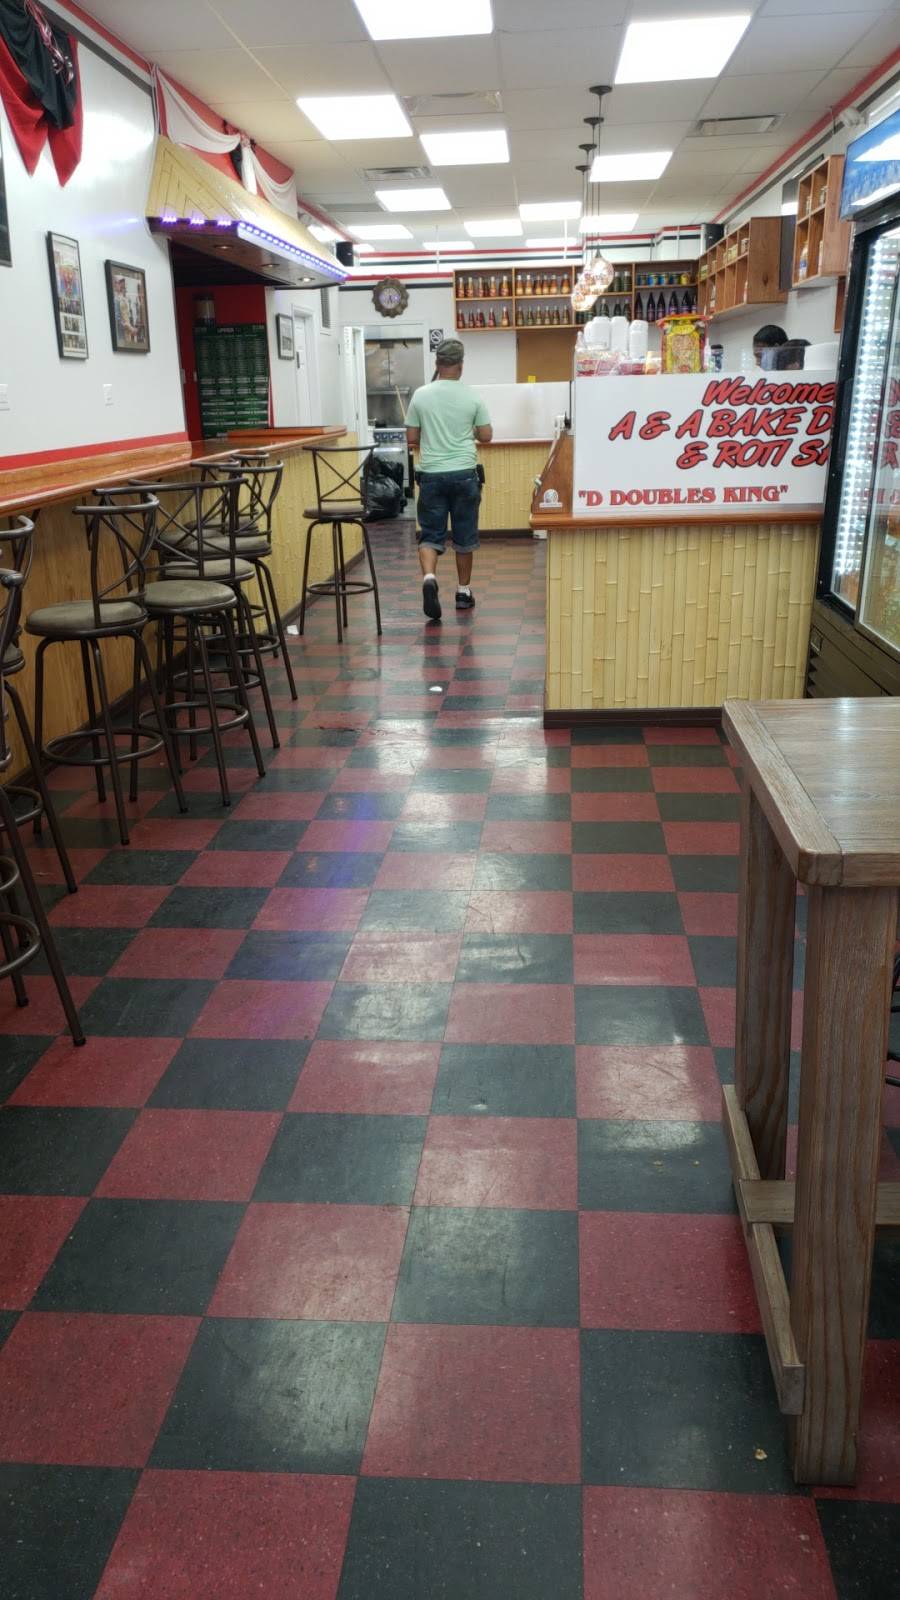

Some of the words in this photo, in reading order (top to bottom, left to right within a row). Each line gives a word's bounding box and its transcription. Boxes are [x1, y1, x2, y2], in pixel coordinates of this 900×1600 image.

[702, 376, 837, 406] Welcome
[608, 410, 637, 441] A
[639, 411, 671, 440] &
[675, 409, 704, 439] A
[706, 406, 807, 438] BAKE
[676, 441, 709, 469] &
[712, 438, 793, 468] ROTI
[610, 487, 716, 506] DOUBLES
[723, 484, 789, 503] KING"
